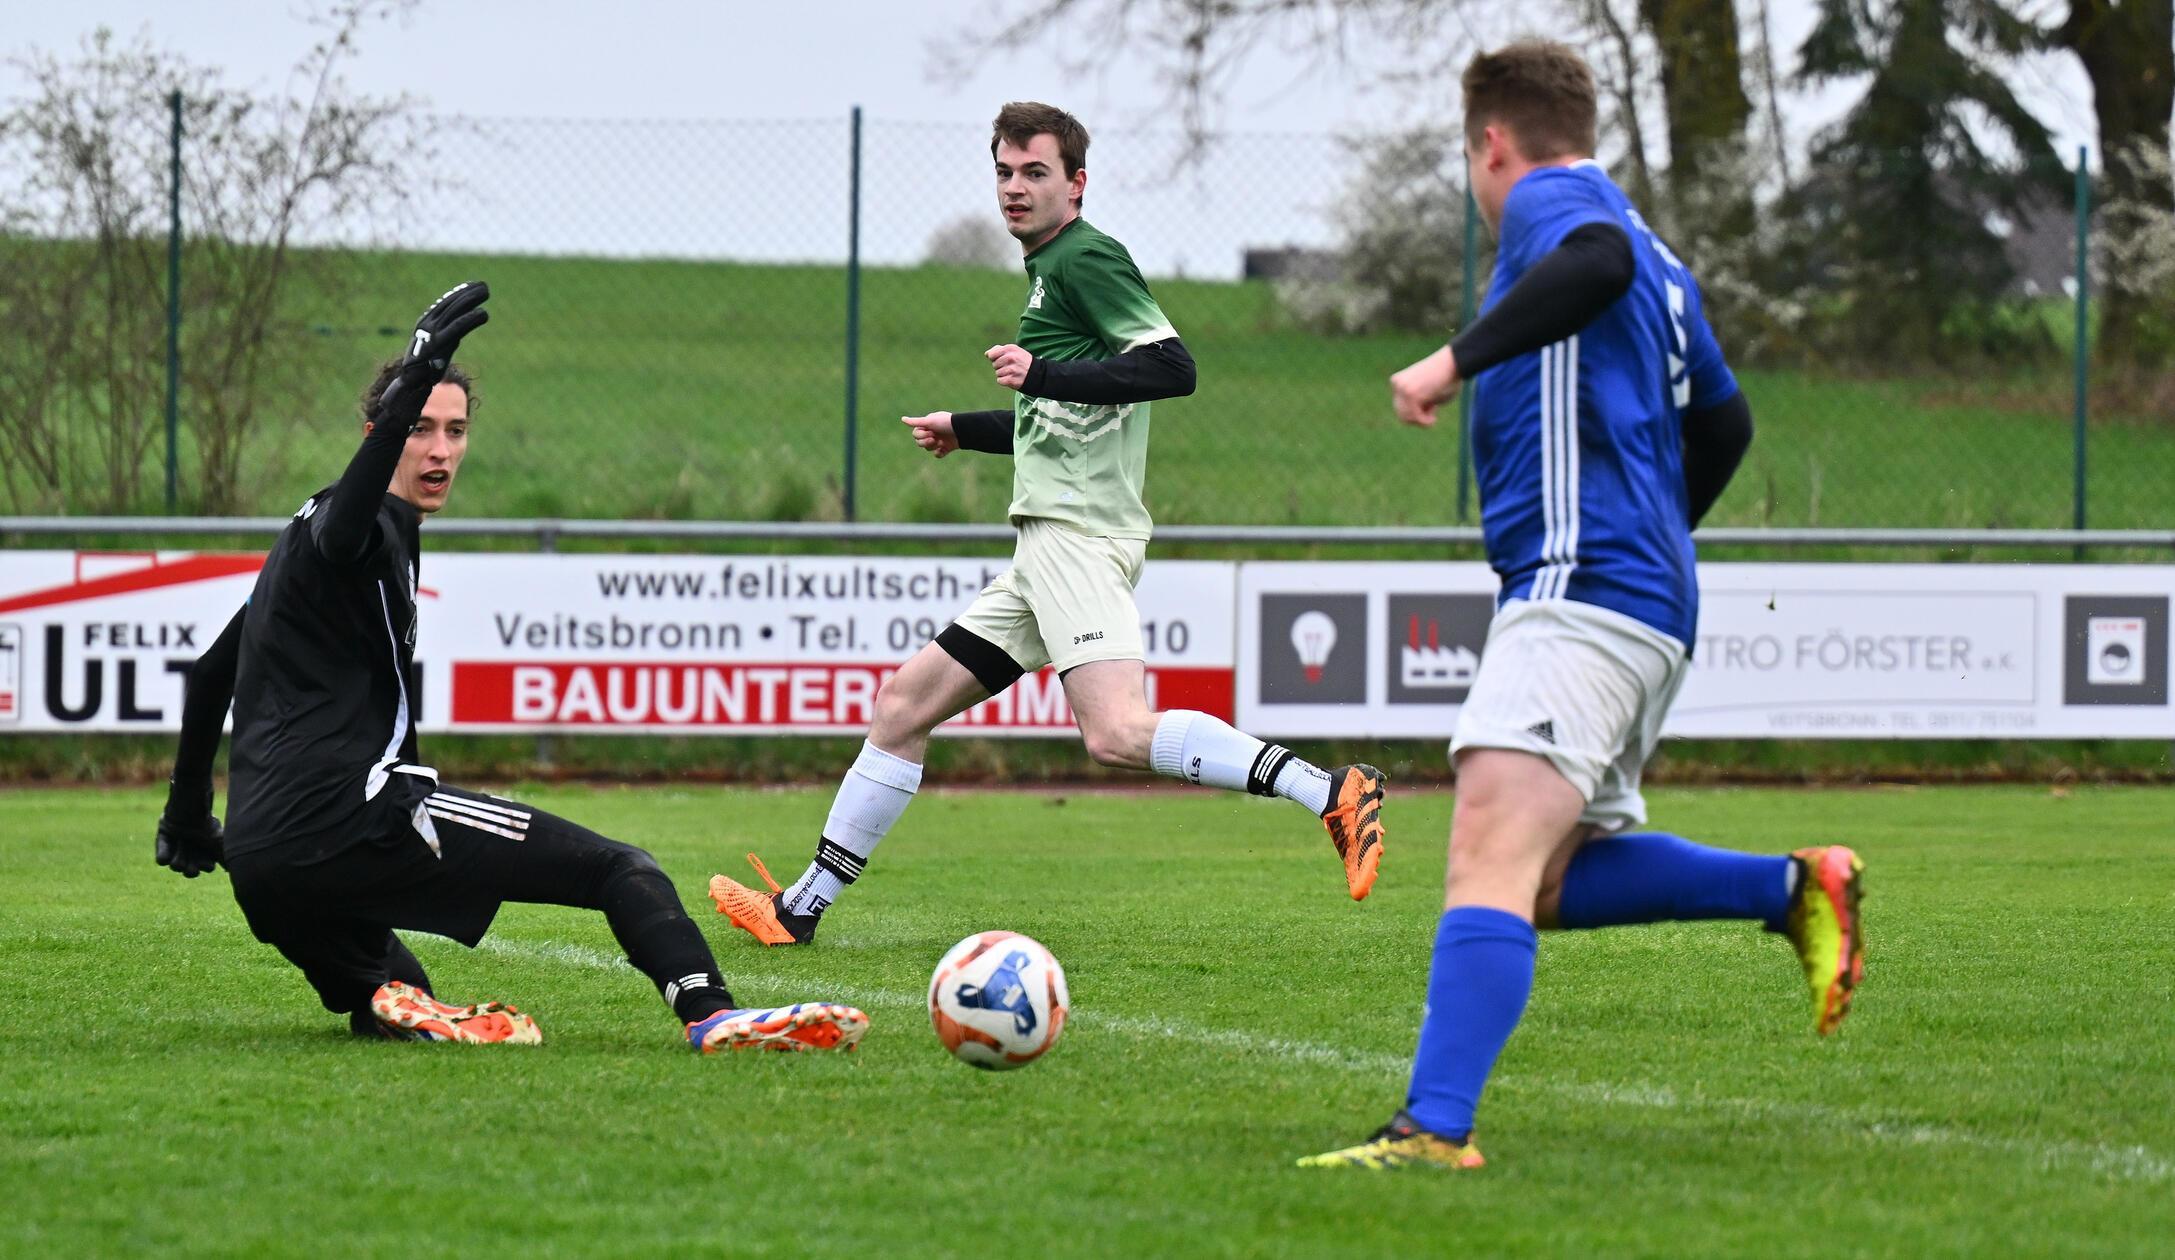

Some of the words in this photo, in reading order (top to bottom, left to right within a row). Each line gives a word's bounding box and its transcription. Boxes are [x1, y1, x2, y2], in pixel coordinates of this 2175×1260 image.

[84, 623, 197, 648] FELIX
[495, 612, 741, 649] Veitsbronn
[790, 615, 869, 652] Tel.
[887, 617, 957, 652] 09
[1081, 630, 1104, 643] DRILLS
[1692, 633, 1782, 671] TRO
[1794, 627, 1972, 671] FÖRSTER
